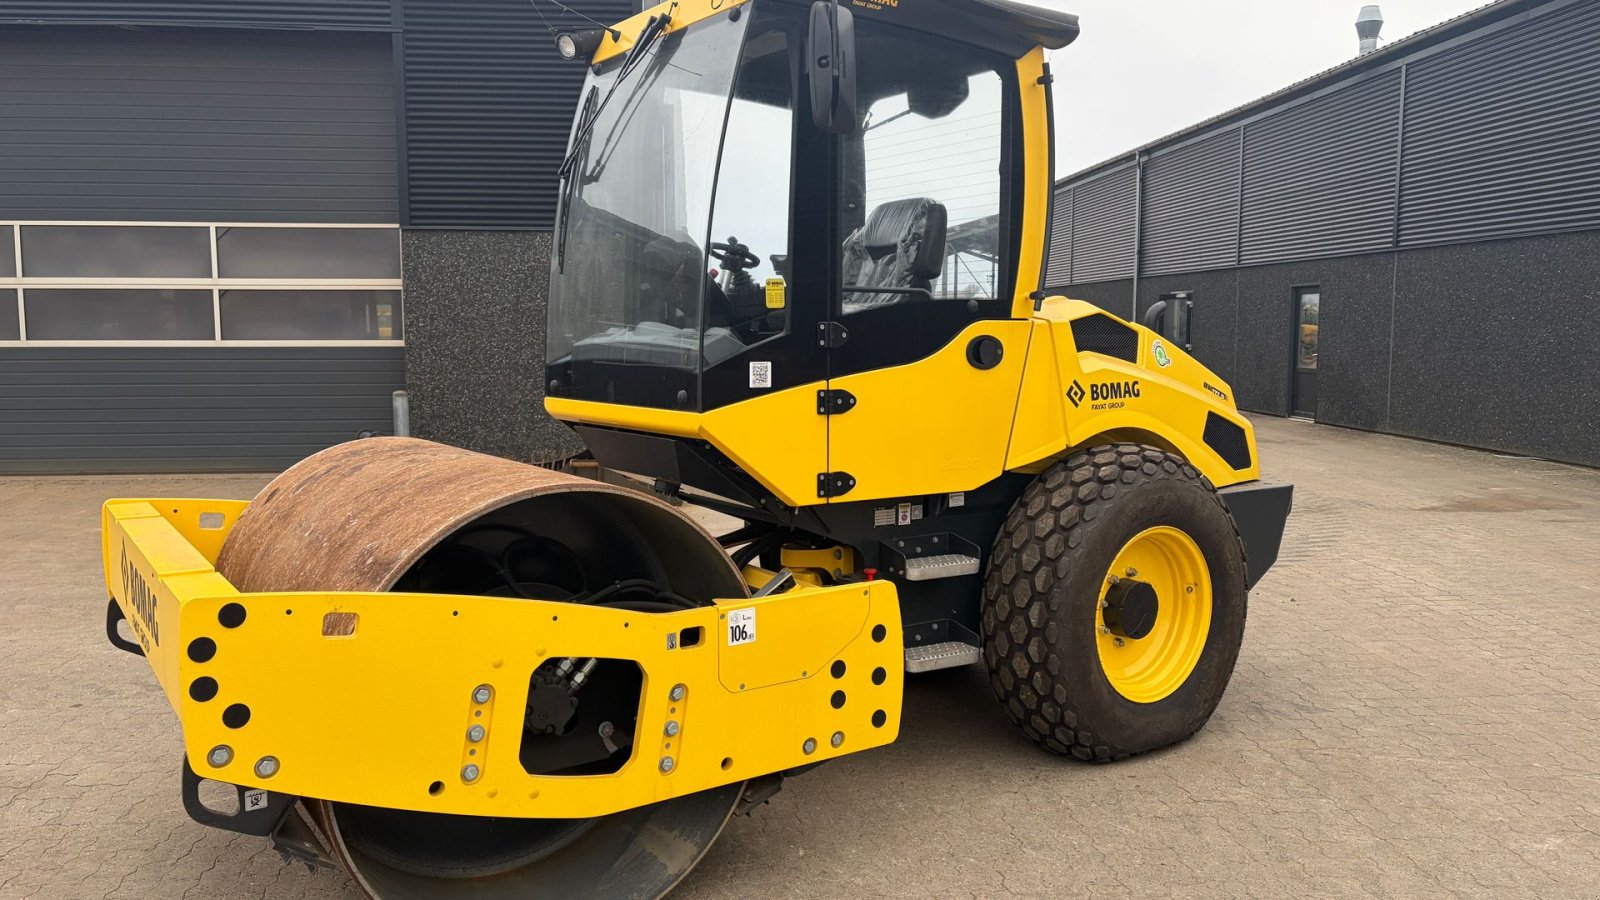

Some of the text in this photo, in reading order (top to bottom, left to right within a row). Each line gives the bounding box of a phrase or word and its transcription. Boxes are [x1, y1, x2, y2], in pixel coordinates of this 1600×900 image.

[1090, 381, 1141, 401] BOMAG
[1108, 401, 1125, 409] GROUP
[129, 559, 160, 648] BOMAG
[729, 624, 748, 643] 106
